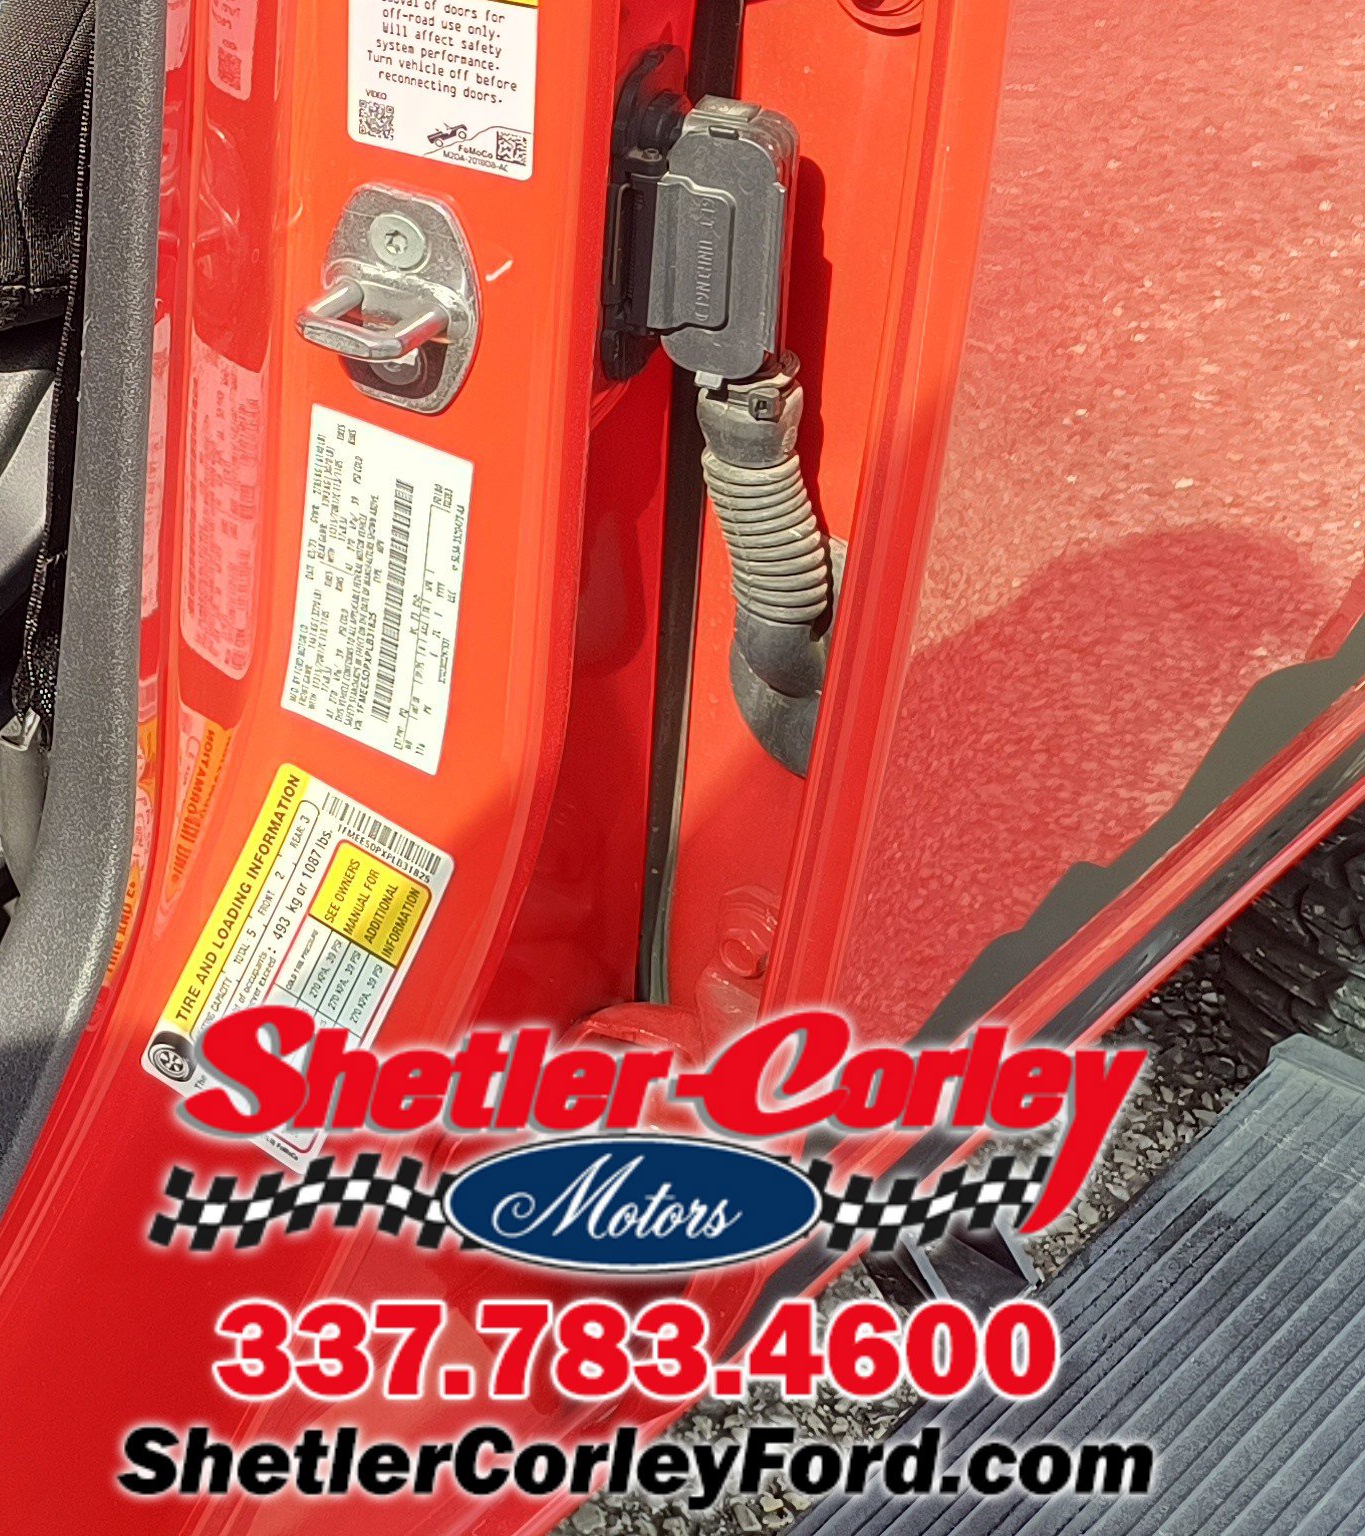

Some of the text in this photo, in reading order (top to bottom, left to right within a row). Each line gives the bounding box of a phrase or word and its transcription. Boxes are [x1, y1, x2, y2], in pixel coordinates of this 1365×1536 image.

[383, 8, 501, 42] off-road use only.
[425, 0, 436, 11] of
[444, 4, 477, 19] doors
[486, 12, 505, 24] for
[376, 39, 500, 71] system performance.
[383, 23, 502, 58] Will affect safety
[367, 50, 517, 92] Turn vehicle off before
[379, 71, 503, 104] reconnecting doors.
[365, 88, 387, 100] VIDEO
[458, 144, 494, 159] FoMoCo
[300, 814, 310, 824] 3
[275, 871, 285, 880] 2
[324, 858, 362, 924] SEE OWNERS
[176, 774, 303, 1024] TIRE AND LOADING INFORMATION
[272, 916, 292, 942] 493
[286, 896, 303, 915] kg
[296, 883, 308, 896] or
[302, 850, 323, 880] 1087
[344, 868, 381, 936] MANUAL FOR
[364, 882, 399, 944] ADDITIONAL
[247, 928, 257, 937] 5
[381, 887, 421, 960] INFORMATION
[310, 983, 322, 999] 270
[328, 995, 340, 1010] 270
[345, 963, 355, 975] 39
